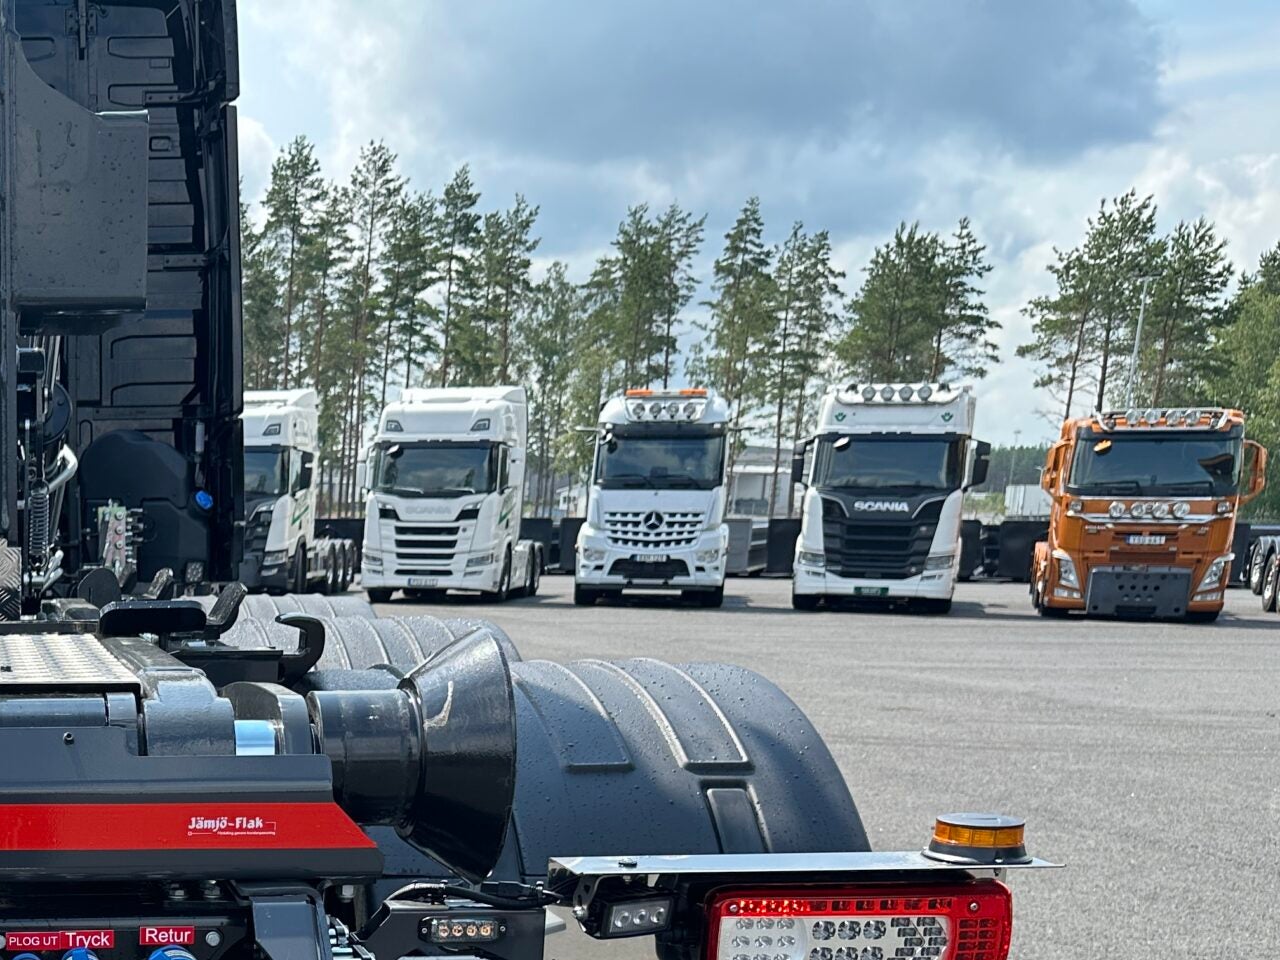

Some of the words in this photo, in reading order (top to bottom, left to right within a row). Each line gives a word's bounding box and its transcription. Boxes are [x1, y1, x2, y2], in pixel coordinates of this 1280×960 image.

[854, 500, 909, 512] SCANIA
[187, 816, 263, 832] Jämjö-Flak
[9, 936, 40, 946] PLOG
[43, 936, 58, 946] UT
[65, 931, 110, 948] Tryck
[145, 928, 191, 943] Retur
